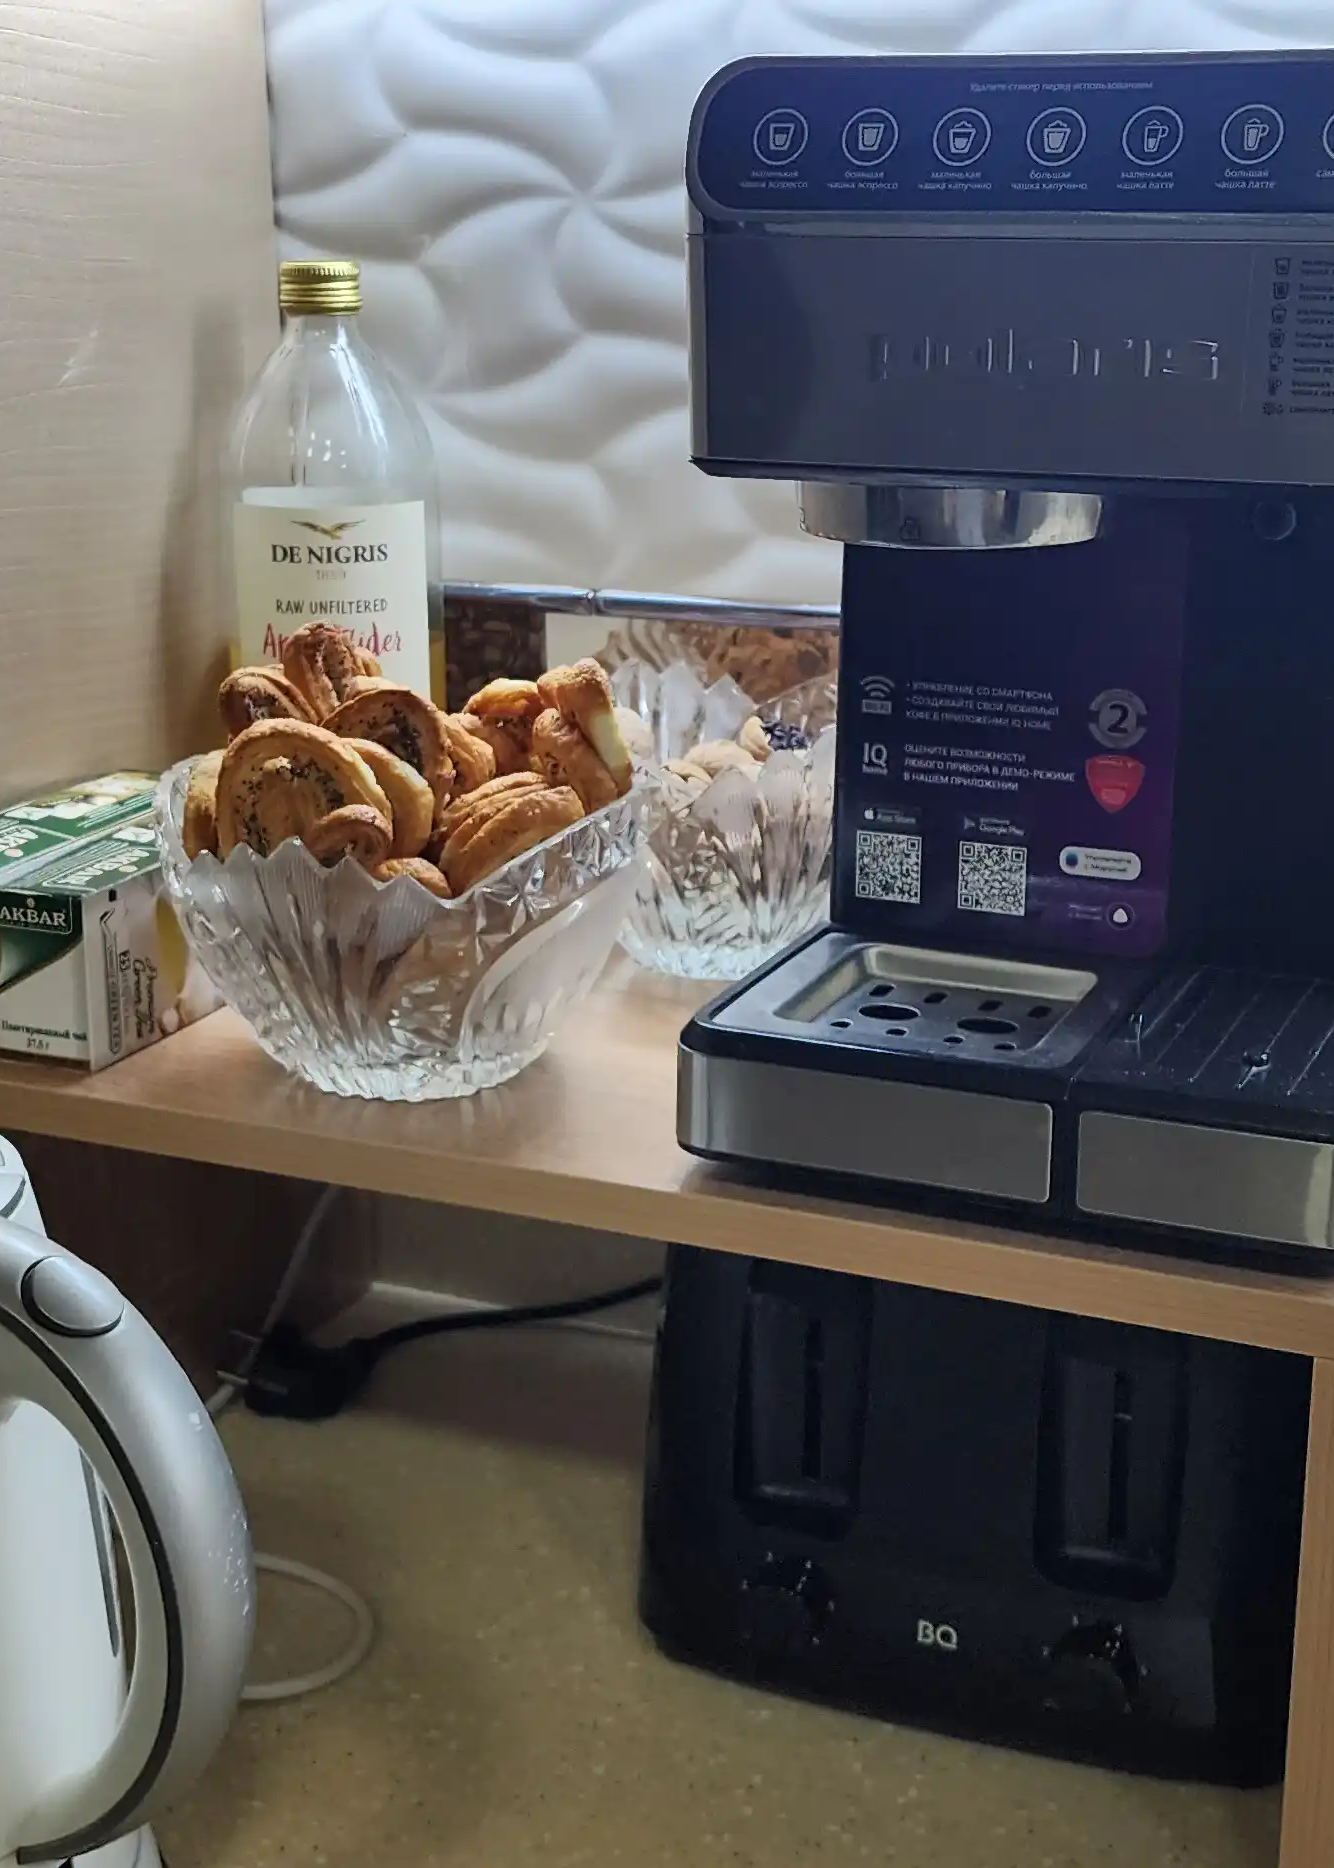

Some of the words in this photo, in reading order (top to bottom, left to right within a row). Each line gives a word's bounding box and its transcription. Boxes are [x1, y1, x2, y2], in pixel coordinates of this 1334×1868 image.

[270, 543, 302, 563] DE
[307, 543, 388, 564] NIGRIS
[276, 599, 303, 614] RAW
[309, 599, 388, 615] UNFILTERED
[1107, 703, 1129, 734] 2
[863, 742, 888, 767] IQ
[911, 773, 949, 785] НАШЕМ
[946, 761, 991, 775] ПРИБОРА
[1000, 766, 1075, 782] ДЕМО-РЕЖИМЕ
[917, 1619, 957, 1650] BQ
